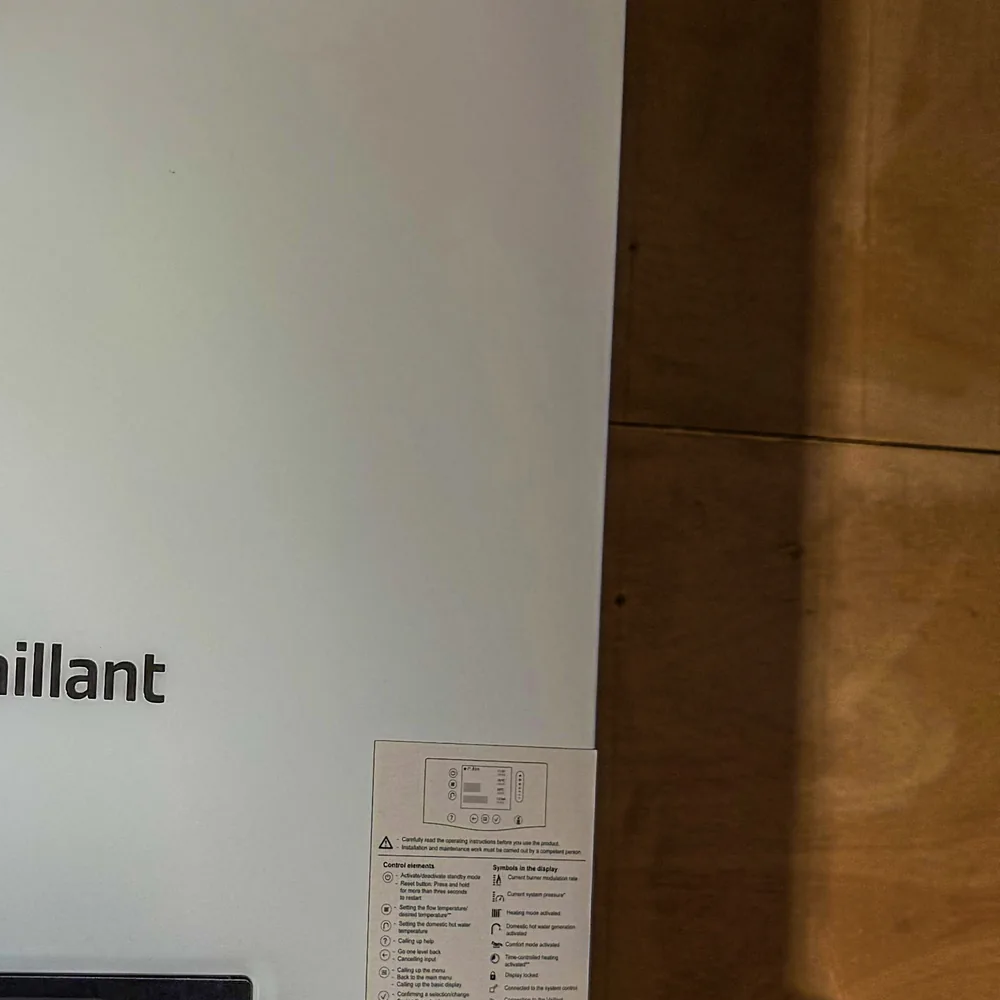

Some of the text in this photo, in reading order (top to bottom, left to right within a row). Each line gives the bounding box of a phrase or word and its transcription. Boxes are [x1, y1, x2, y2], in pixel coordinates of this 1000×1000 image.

[402, 836, 423, 844] Carefully
[446, 837, 468, 845] operating
[540, 847, 564, 855] competent
[493, 864, 518, 872] Symbols
[537, 865, 558, 873] display
[448, 873, 466, 881] standby
[399, 904, 416, 912] Setting
[397, 981, 413, 989] Calling
[445, 981, 461, 989] display
